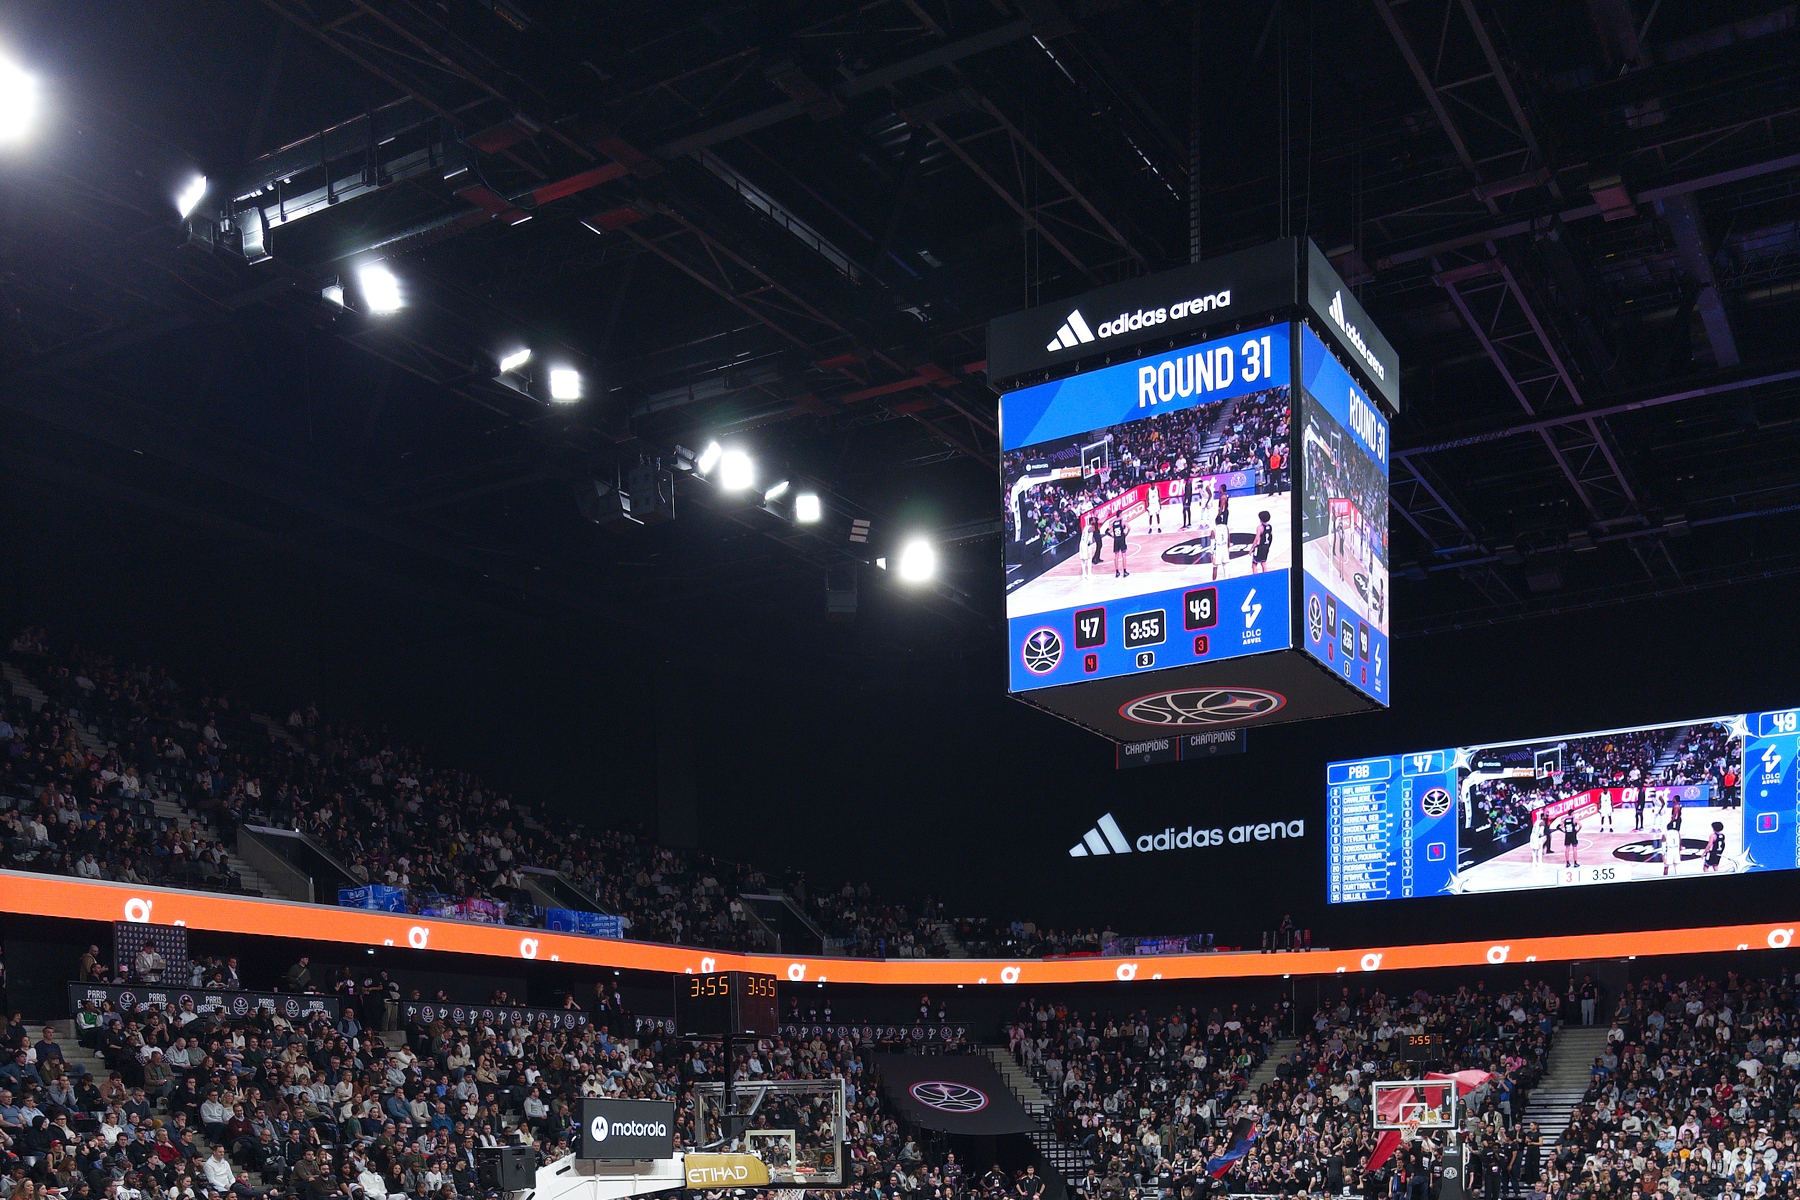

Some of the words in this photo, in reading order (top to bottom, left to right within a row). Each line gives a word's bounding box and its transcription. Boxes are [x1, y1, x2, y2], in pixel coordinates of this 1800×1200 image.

[1098, 308, 1168, 338] adidas
[1170, 290, 1231, 319] arena
[1346, 322, 1367, 359] adidas
[1366, 349, 1385, 381] arena
[1139, 346, 1234, 408] ROUND
[1241, 336, 1271, 383] 31
[1350, 387, 1376, 452] ROUND
[1377, 422, 1386, 464] 31
[1190, 598, 1211, 622] 49
[1081, 618, 1100, 639] 47
[1130, 618, 1160, 640] 3:55
[1242, 628, 1262, 638] LDLC
[1198, 640, 1204, 651] 3
[1088, 659, 1094, 668] 4
[1142, 656, 1148, 666] 3
[1773, 712, 1797, 733] 49
[1190, 731, 1236, 746] CHAMPIONS
[1125, 740, 1169, 756] CHAMPIONS
[1413, 754, 1432, 772] 47
[1348, 765, 1370, 779] PBB
[1764, 816, 1772, 828] 3
[1136, 827, 1224, 852] adidas
[1228, 819, 1304, 844] arena
[1566, 872, 1572, 883] 3
[1592, 868, 1616, 881] 3:55
[88, 990, 106, 999] PARIS
[691, 976, 729, 998] 3:55
[748, 976, 776, 998] 3:55
[148, 992, 167, 1002] PARIS
[205, 996, 222, 1004] PARIS
[258, 998, 274, 1006] PARIS
[1408, 1035, 1430, 1046] 3:55
[611, 1120, 666, 1138] motorola
[688, 1165, 748, 1184] ETIHAD
